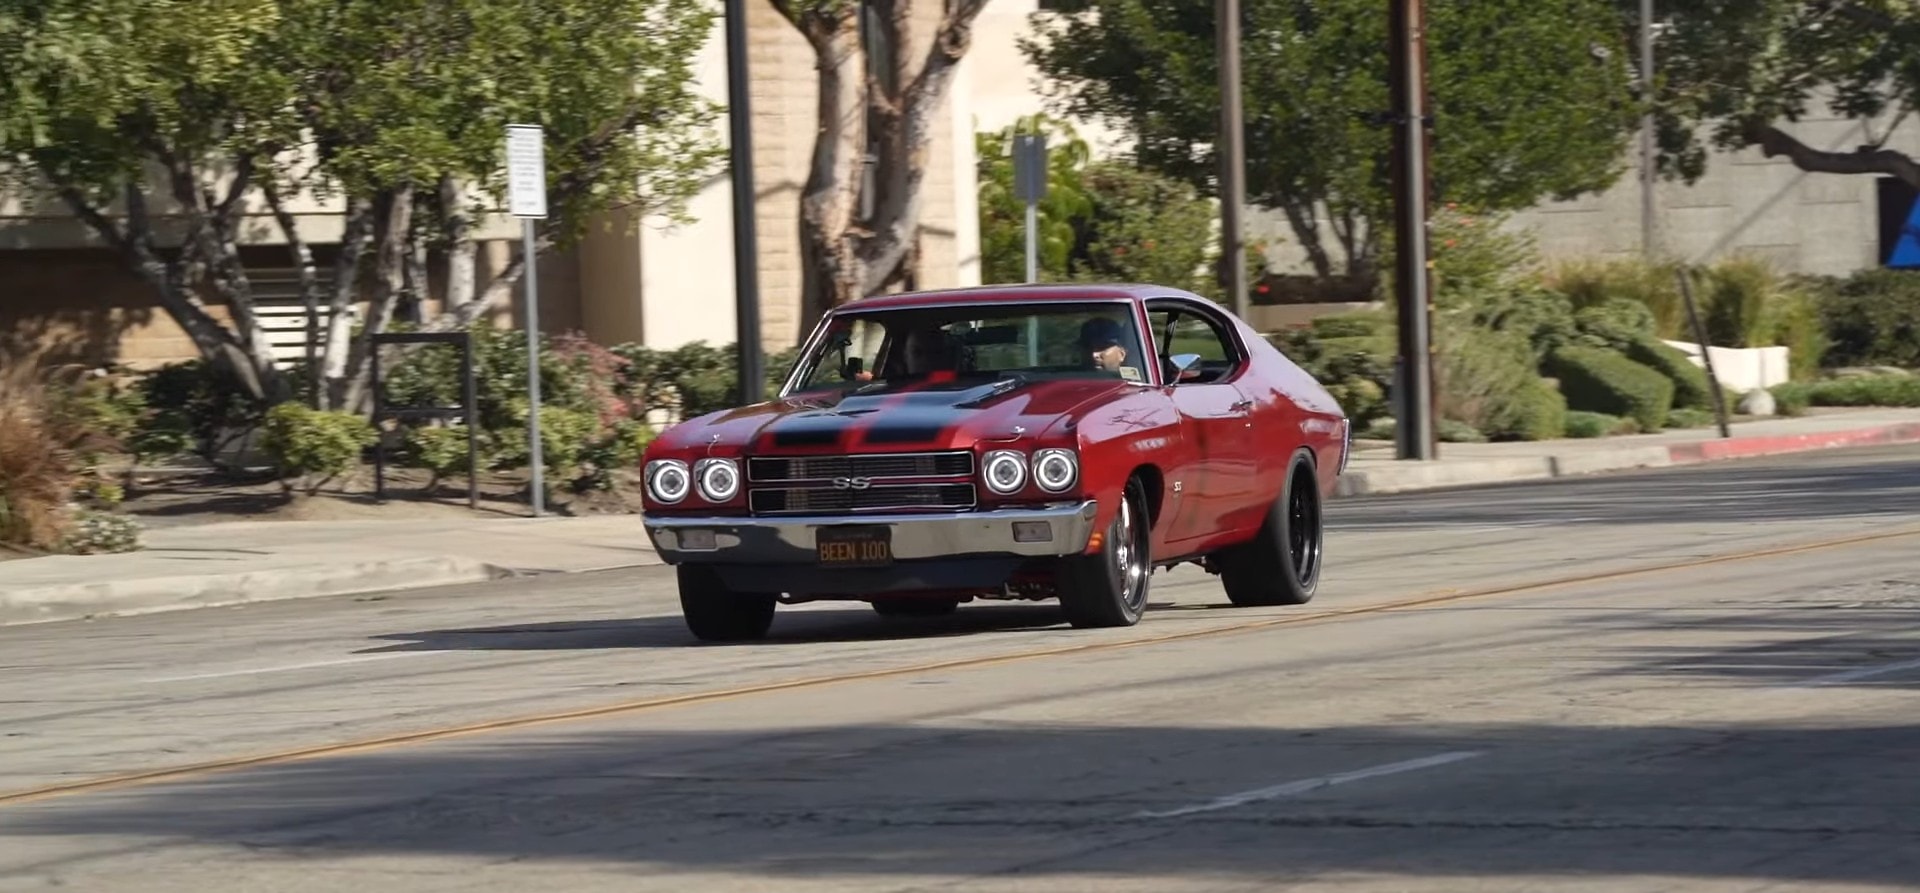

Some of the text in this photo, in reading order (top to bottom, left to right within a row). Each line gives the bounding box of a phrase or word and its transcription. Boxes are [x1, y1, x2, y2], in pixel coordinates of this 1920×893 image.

[833, 476, 870, 490] SS
[820, 541, 887, 561] BEEN 100
